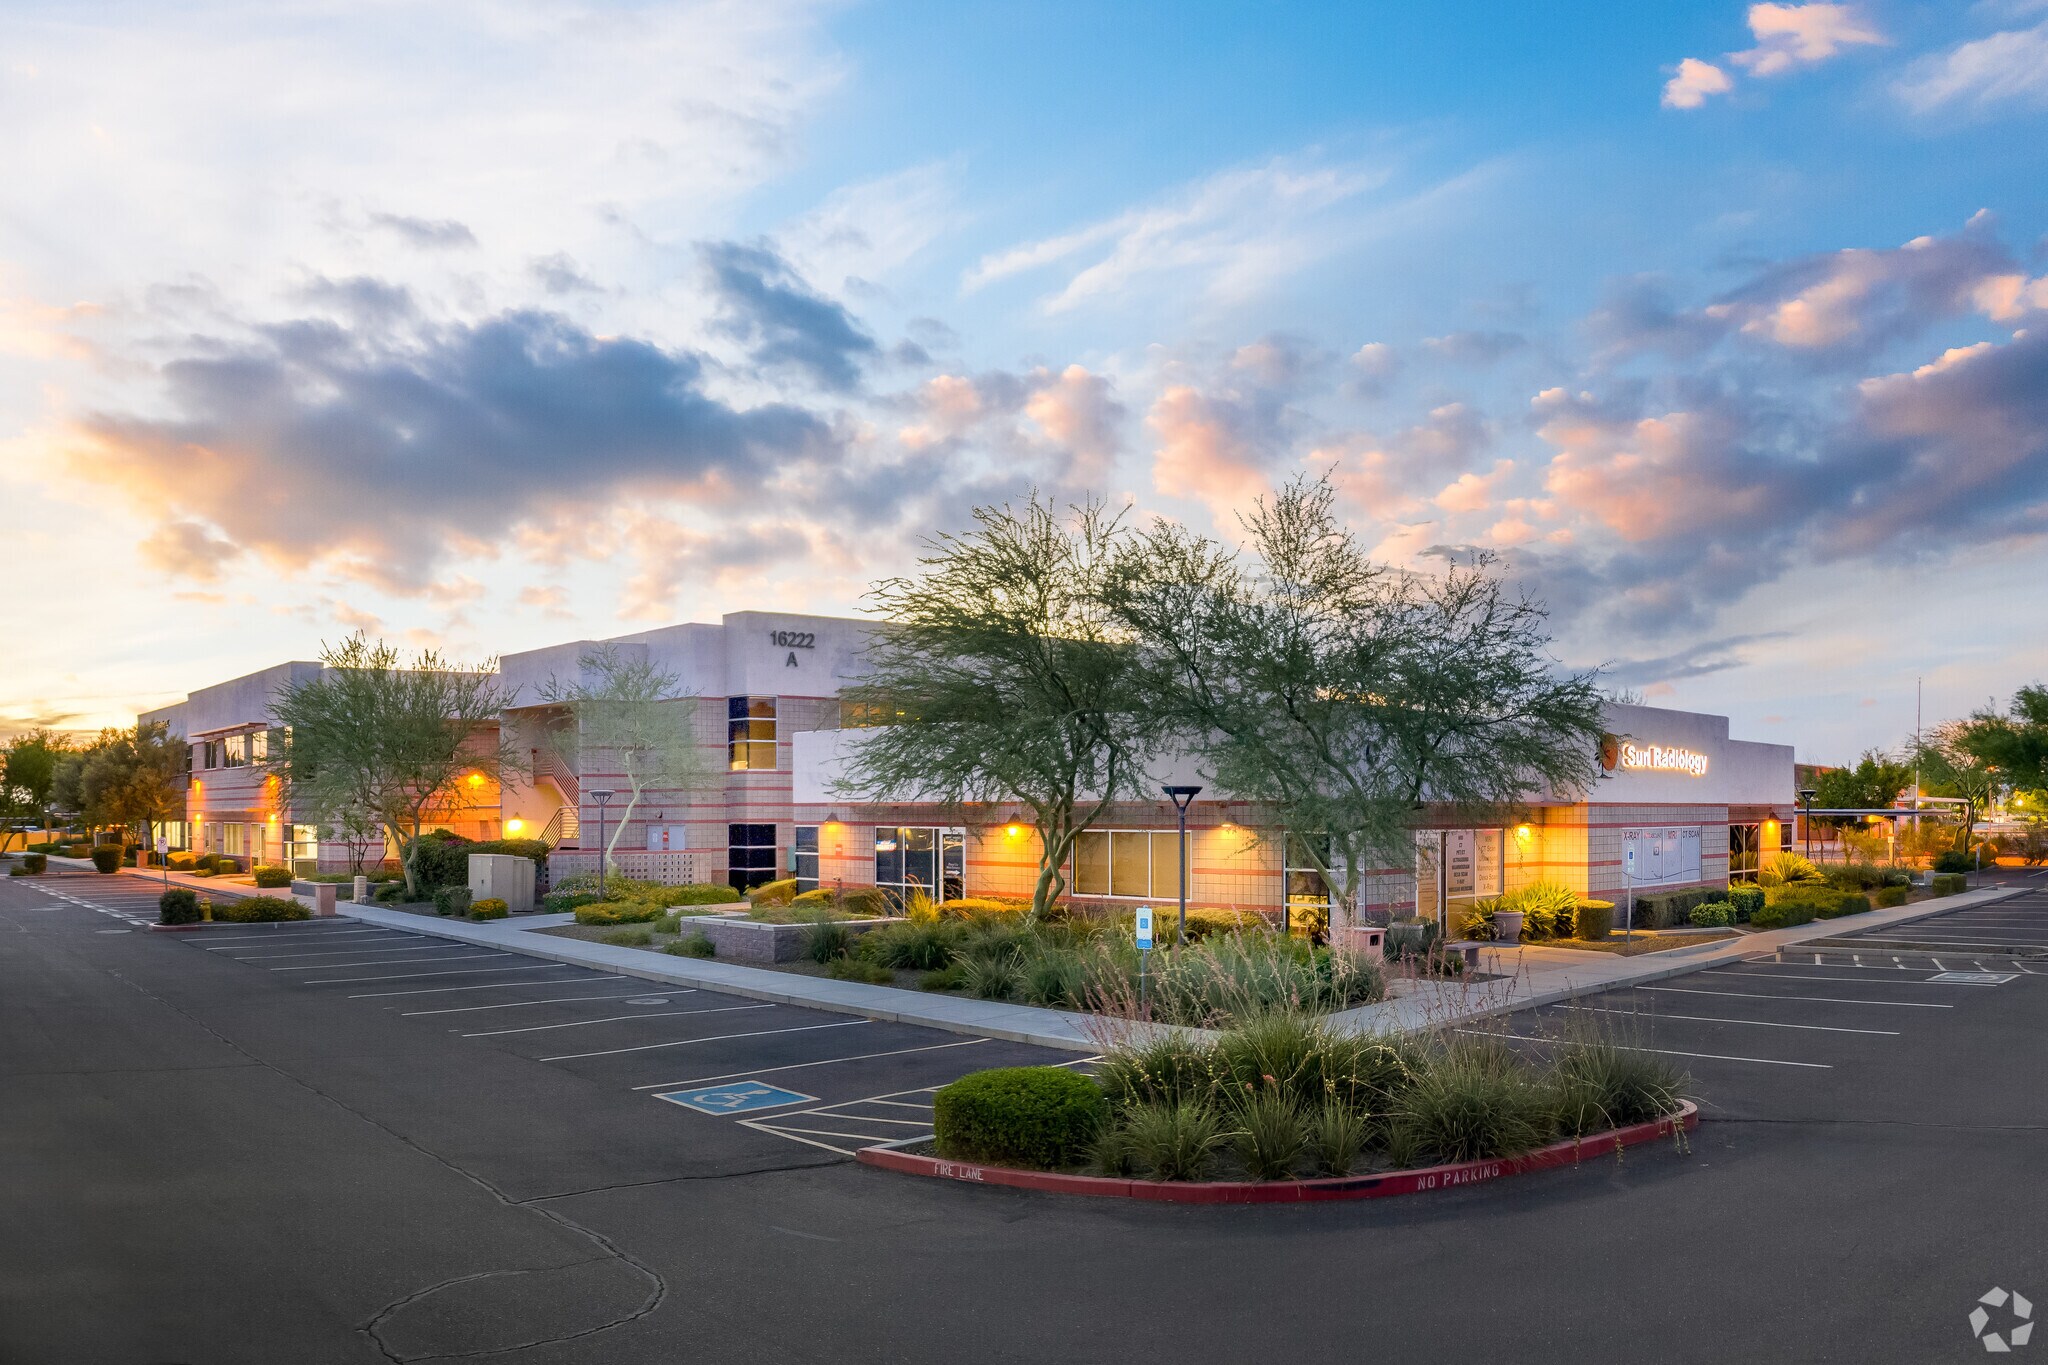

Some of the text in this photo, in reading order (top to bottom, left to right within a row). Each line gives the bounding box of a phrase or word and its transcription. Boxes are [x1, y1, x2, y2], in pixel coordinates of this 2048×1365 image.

[770, 630, 815, 649] 16222
[786, 651, 798, 667] A
[1622, 744, 1708, 775] Sun Radiology
[1623, 831, 1641, 841] X-RAY
[934, 1162, 984, 1180] FIRE LANE
[1418, 1164, 1499, 1190] NO PARKING
